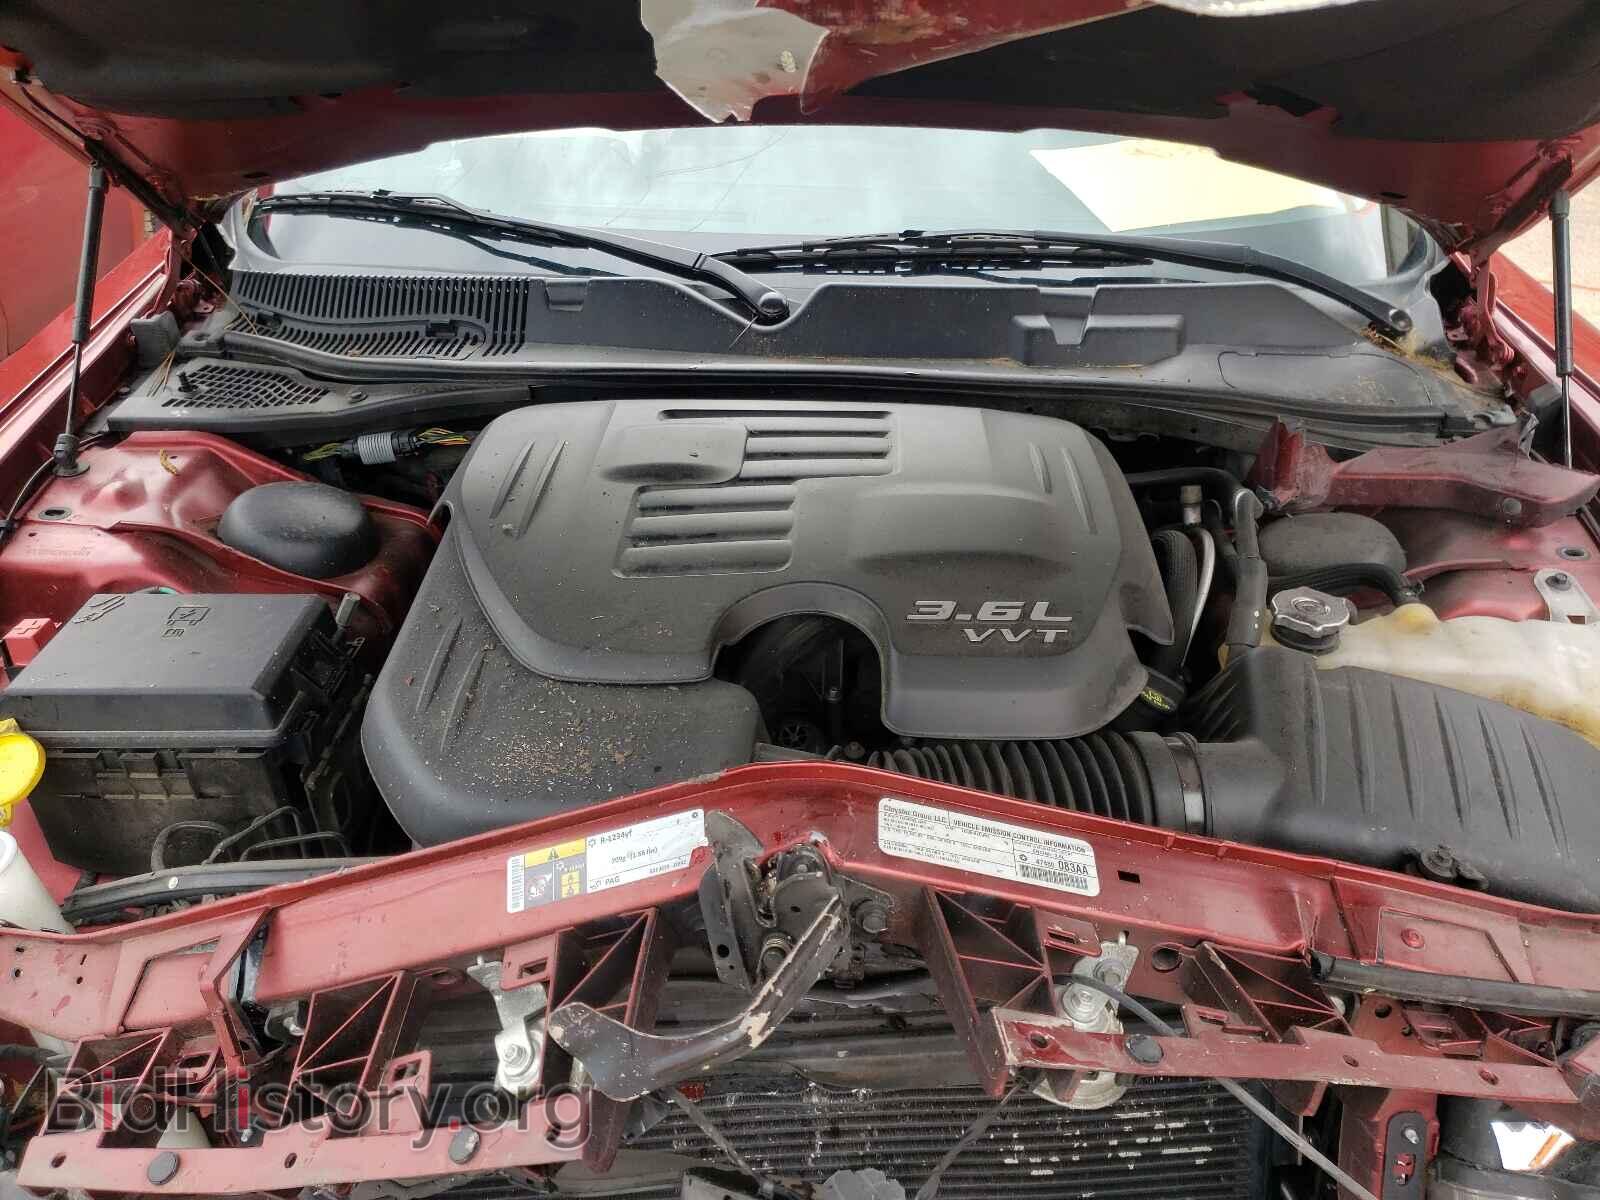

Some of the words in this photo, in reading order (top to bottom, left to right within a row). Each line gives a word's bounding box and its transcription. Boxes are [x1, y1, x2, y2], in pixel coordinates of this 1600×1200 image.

[906, 599, 1073, 622] 3.6L
[963, 627, 1069, 643] VVT
[953, 818, 979, 831] VEHICLE
[981, 824, 1012, 838] EMISSION
[1013, 832, 1041, 845] CONTROL
[1043, 839, 1086, 854] INFORMATION
[1057, 860, 1089, 876] 083AA
[604, 875, 621, 886] PAG
